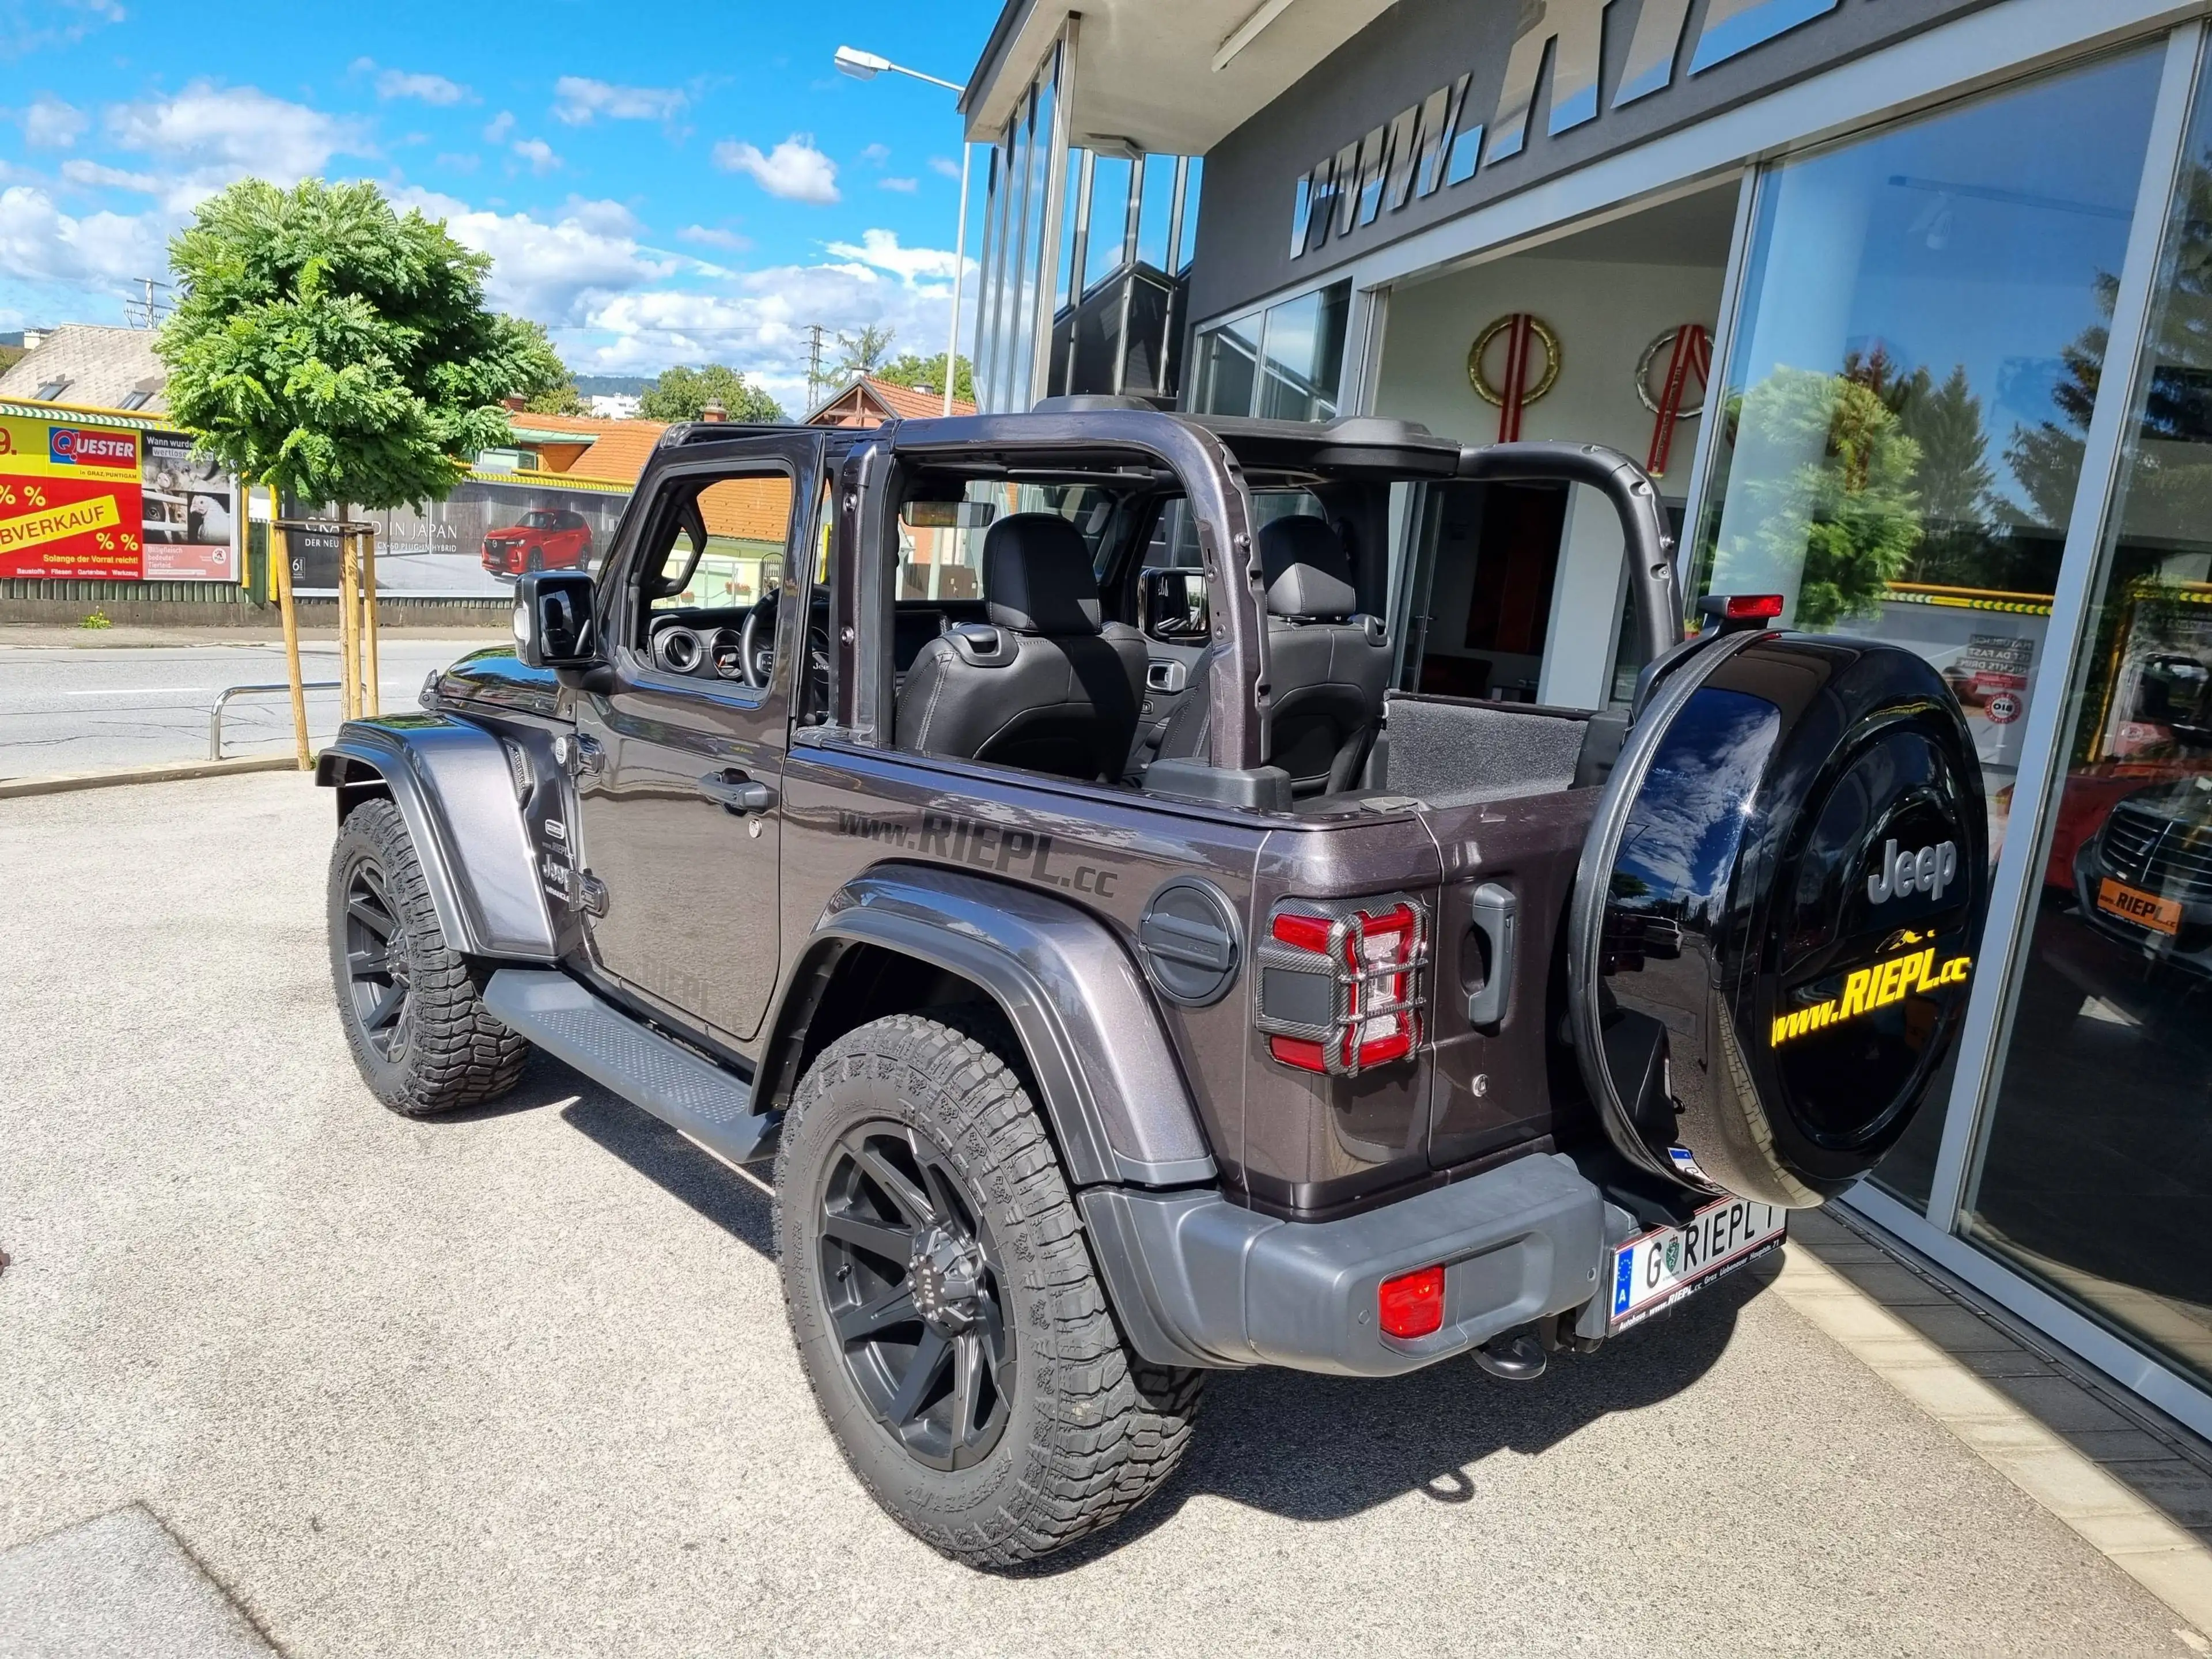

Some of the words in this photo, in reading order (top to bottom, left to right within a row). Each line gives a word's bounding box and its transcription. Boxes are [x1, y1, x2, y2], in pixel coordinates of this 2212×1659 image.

[52, 430, 134, 461] QUESTER
[146, 436, 168, 446] Wann
[0, 505, 104, 545] BVERKAUF
[390, 521, 405, 536] IN
[411, 522, 457, 540] JAPAN
[43, 554, 75, 563] Solange
[77, 555, 89, 563] der
[92, 555, 114, 564] Vorrat
[115, 556, 138, 565] reicht!
[305, 538, 321, 547] DER
[377, 541, 399, 550] CX-60
[401, 542, 430, 552] PLUG-IN
[432, 544, 457, 552] HYBRID
[838, 807, 1118, 899] www.RIEPL.cc
[1868, 838, 1957, 905] Jeep
[1771, 947, 1971, 1048] www.RIEPL.cc
[1646, 1242, 1662, 1289] G
[1683, 1202, 1755, 1272] RIEPL
[1618, 1288, 1627, 1304] A
[1619, 1312, 1646, 1331] Autohaus
[1704, 1274, 1718, 1285] Graz
